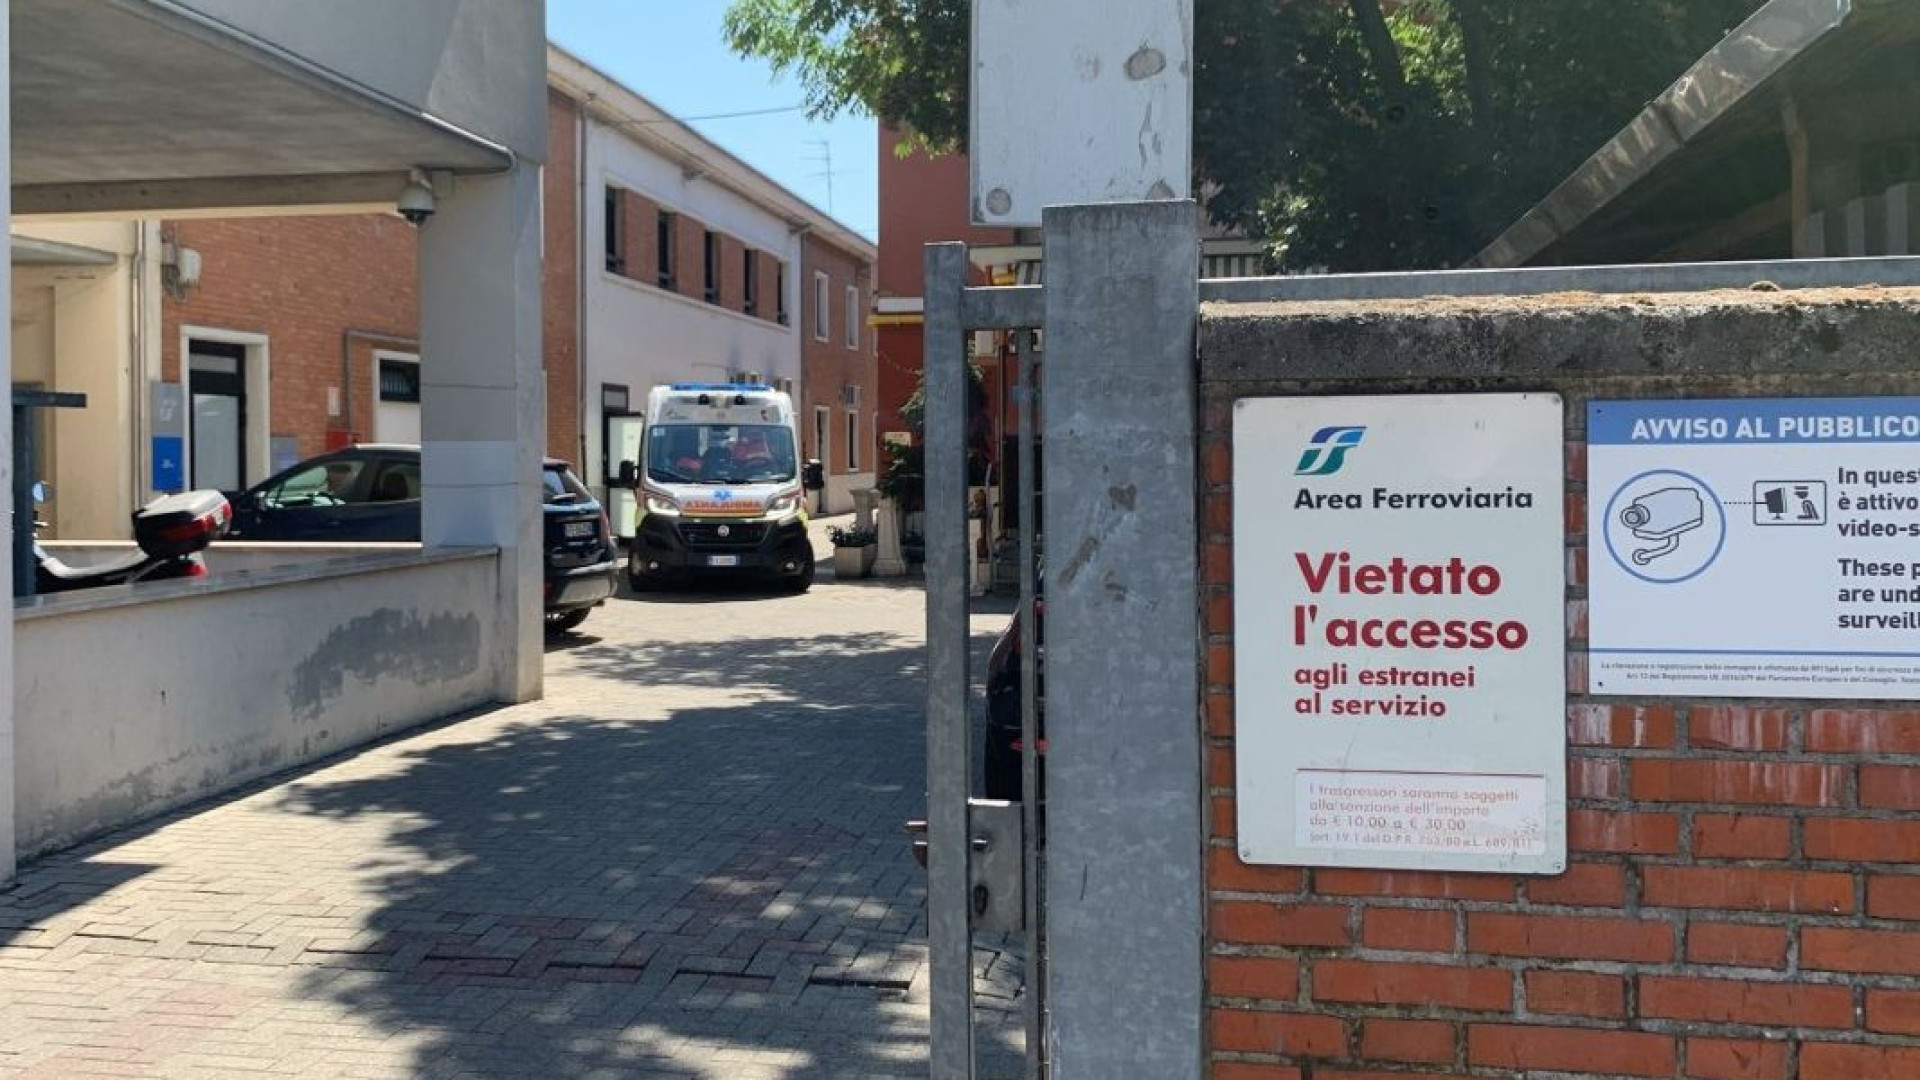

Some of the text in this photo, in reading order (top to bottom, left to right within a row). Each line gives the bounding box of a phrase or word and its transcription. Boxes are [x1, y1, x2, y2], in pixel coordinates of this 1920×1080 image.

[1631, 415, 1919, 440] AVVISO AL PUBBLICO
[1838, 467, 1920, 488] In ques
[1294, 487, 1533, 509] Area Ferroviaria
[1838, 491, 1919, 510] è attivo
[1294, 551, 1501, 595] Vietato
[1838, 558, 1905, 577] These
[1838, 585, 1920, 603] are und
[1294, 604, 1528, 649] l'accesso
[1294, 663, 1475, 689] agli estranei
[1294, 693, 1446, 716] al servizio
[1309, 814, 1327, 826] da
